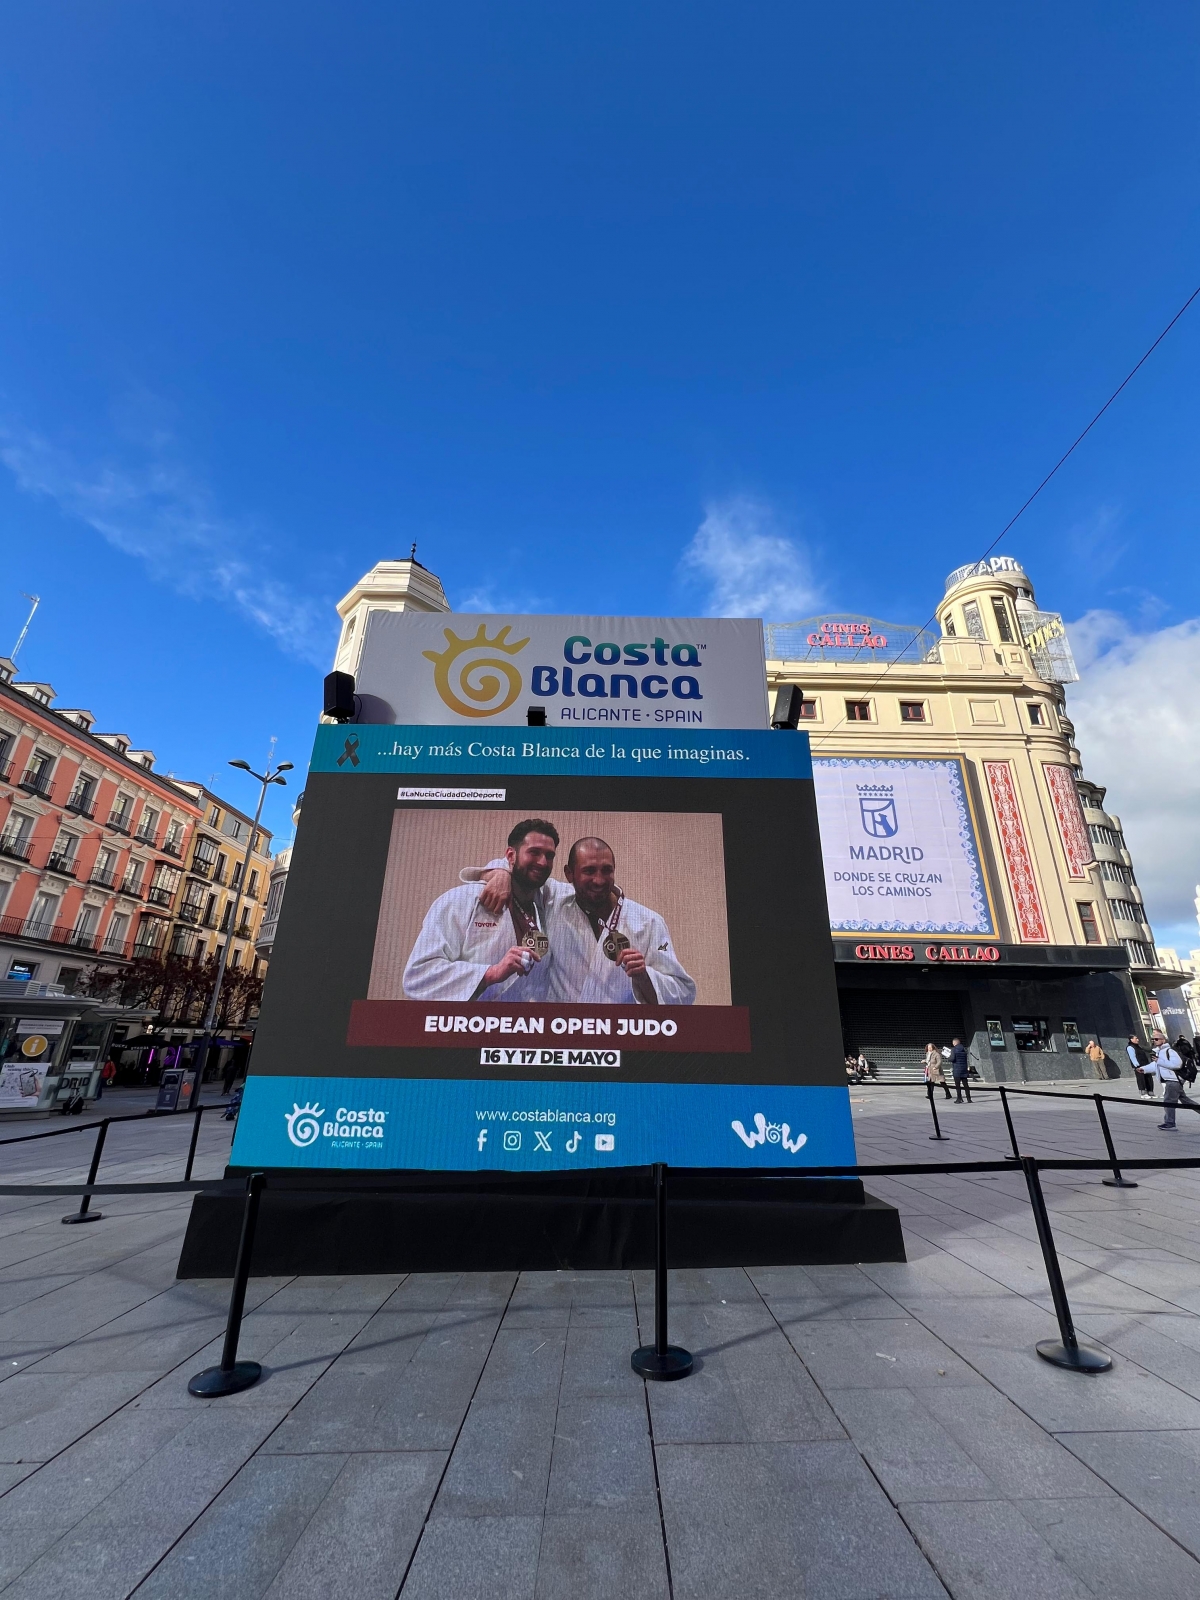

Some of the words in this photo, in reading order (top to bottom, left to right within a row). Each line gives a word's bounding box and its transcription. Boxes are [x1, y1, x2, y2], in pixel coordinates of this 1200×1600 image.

[821, 622, 871, 635] CINES
[807, 633, 888, 648] CALLAO
[563, 635, 702, 667] Costa
[531, 666, 704, 700] Blanca
[561, 707, 642, 721] ALICANTE
[654, 709, 703, 723] SPAIN
[428, 742, 462, 757] más
[467, 742, 516, 757] Costa
[521, 743, 580, 758] Blanca
[585, 744, 606, 758] de
[611, 744, 626, 759] la
[631, 747, 662, 763] que
[667, 744, 750, 764] imaginas.
[400, 790, 503, 799] #LaNuciaCiudadDelDeporte
[849, 845, 924, 864] MADRID
[833, 871, 875, 882] DONDE
[878, 872, 892, 882] SE
[895, 873, 943, 885] CRUZAN
[852, 886, 874, 896] LOS
[877, 886, 932, 897] CAMINOS
[855, 944, 915, 961] CINES
[925, 946, 1000, 962] CALLAO
[424, 1015, 544, 1034] EUROPEAN
[550, 1017, 611, 1035] OPEN
[616, 1019, 678, 1037] JUDO
[484, 1050, 500, 1063] 16
[506, 1050, 519, 1064] Y
[520, 1050, 535, 1064] 17
[541, 1051, 563, 1065] DE
[568, 1051, 617, 1066] MAYO
[335, 1107, 386, 1123] Costa
[475, 1109, 616, 1126] www.costablanca.org
[323, 1122, 384, 1138] Blanca
[331, 1140, 361, 1149] ALICANTE
[365, 1141, 384, 1149] SPAIN
